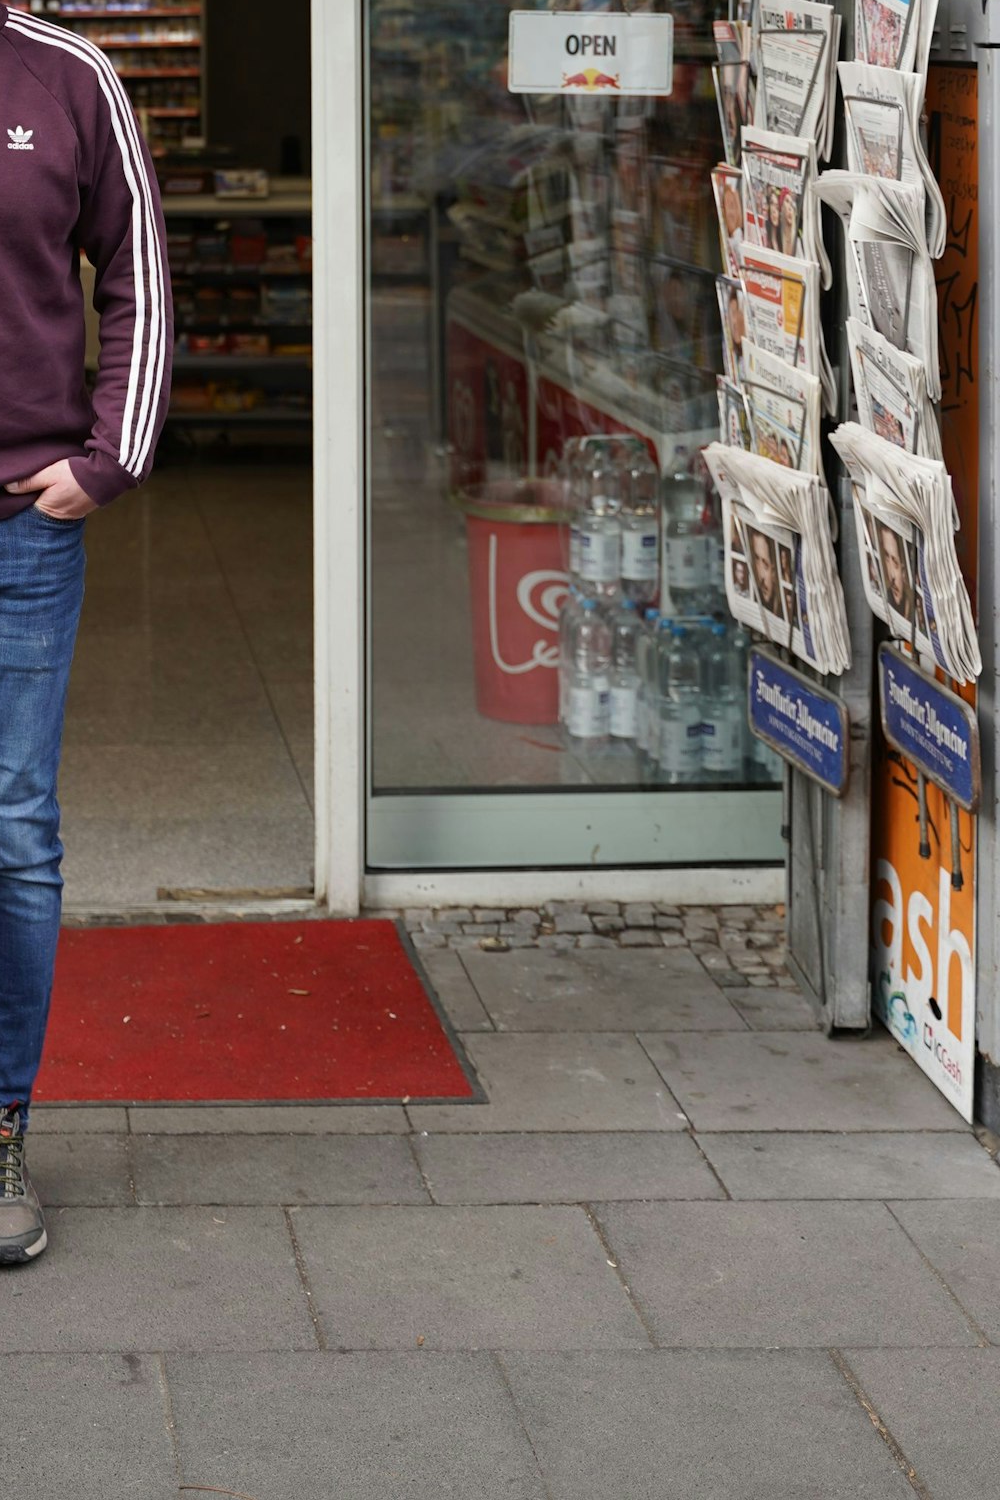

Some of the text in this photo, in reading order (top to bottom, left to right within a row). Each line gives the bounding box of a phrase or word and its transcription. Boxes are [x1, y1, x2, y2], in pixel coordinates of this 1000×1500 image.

[565, 34, 617, 56] OPEN
[7, 142, 34, 150] adidas
[795, 697, 839, 753] Allgemeine
[924, 700, 967, 761] Allgemeine
